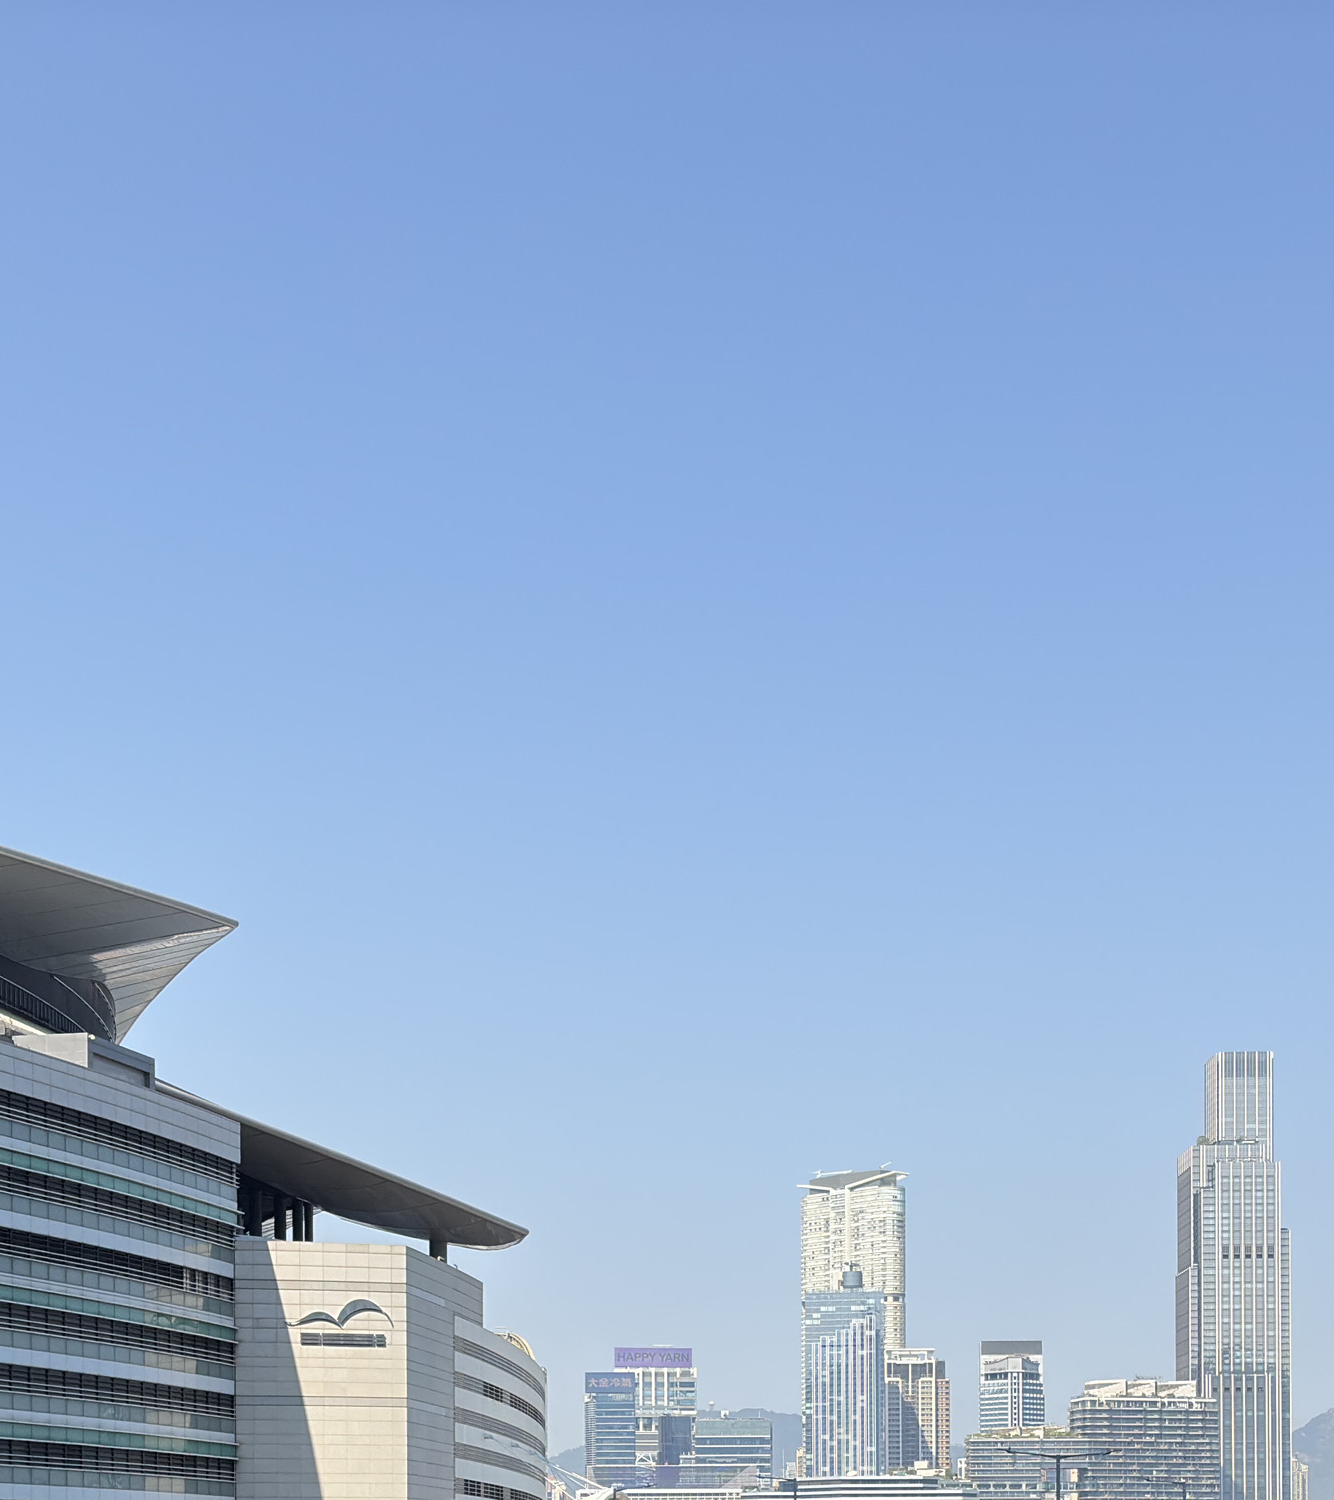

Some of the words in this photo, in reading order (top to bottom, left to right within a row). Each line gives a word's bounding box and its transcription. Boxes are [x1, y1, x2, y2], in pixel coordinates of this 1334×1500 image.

[618, 1352, 656, 1362] HAPPY
[659, 1352, 690, 1362] YARN
[588, 1378, 632, 1388] 大金冷氣
